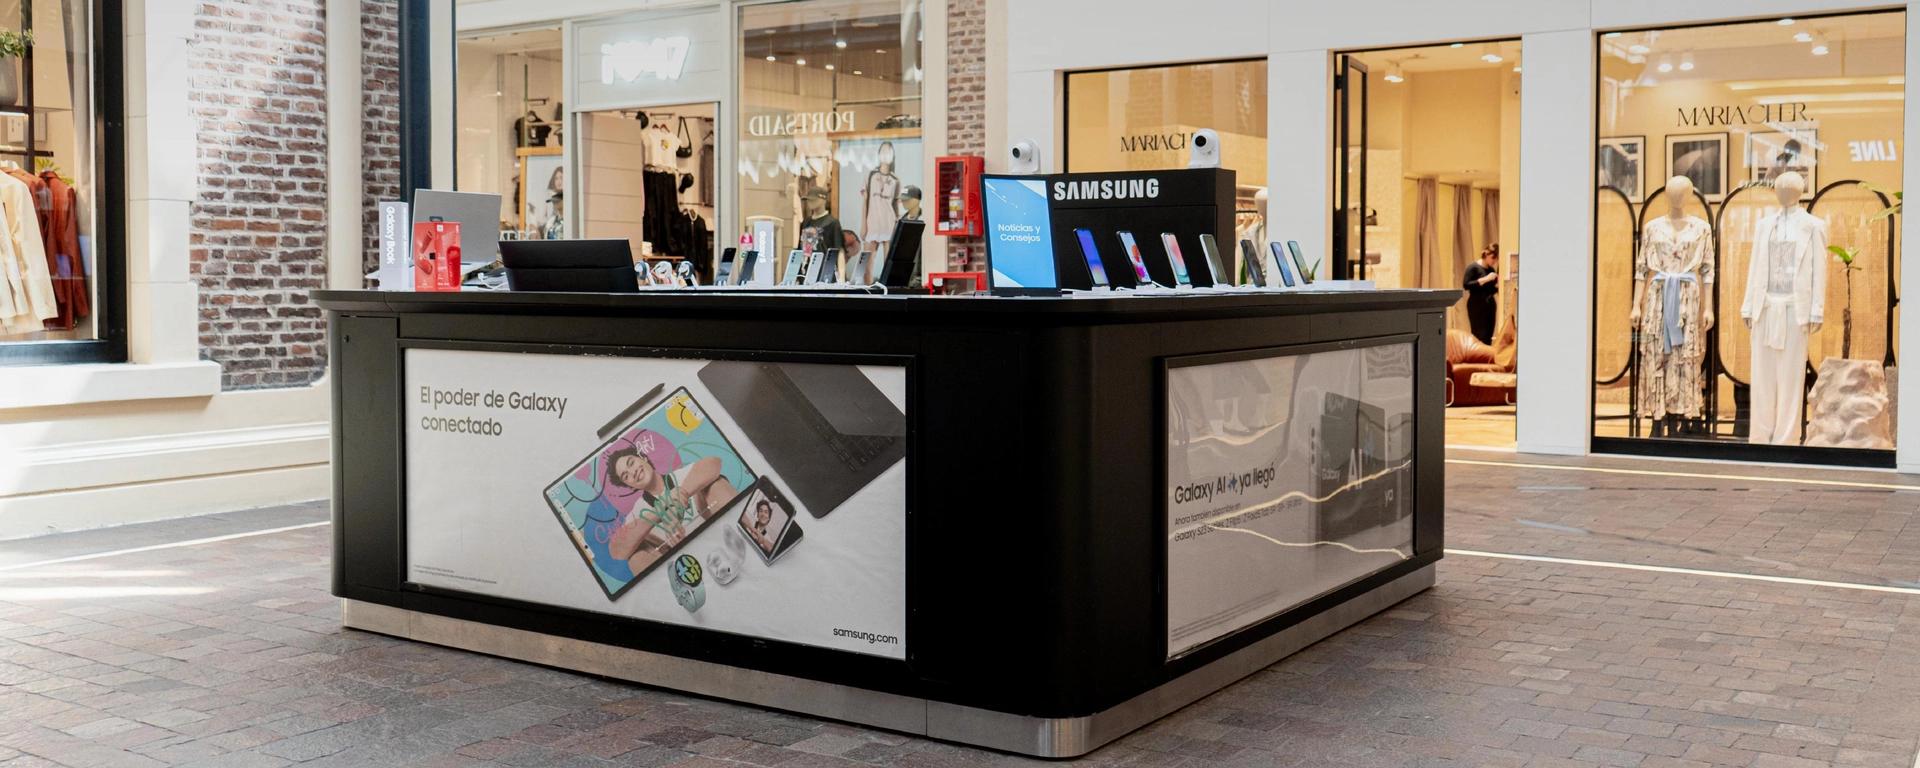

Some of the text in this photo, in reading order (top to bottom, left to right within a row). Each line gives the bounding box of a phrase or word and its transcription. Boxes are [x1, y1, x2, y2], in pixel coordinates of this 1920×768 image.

[1053, 178, 1160, 201] SAMSUNG
[384, 206, 396, 264] Galaxy Book
[997, 224, 1041, 235] Noticias y
[1000, 233, 1041, 244] Consejos
[420, 386, 568, 419] El poder de Galaxy
[421, 416, 503, 436] conectado
[1174, 461, 1275, 505] Galaxy AI ya llegó
[1175, 512, 1191, 526] Ahora
[1174, 528, 1197, 542] Galaxy
[832, 627, 898, 645] samsung.com
